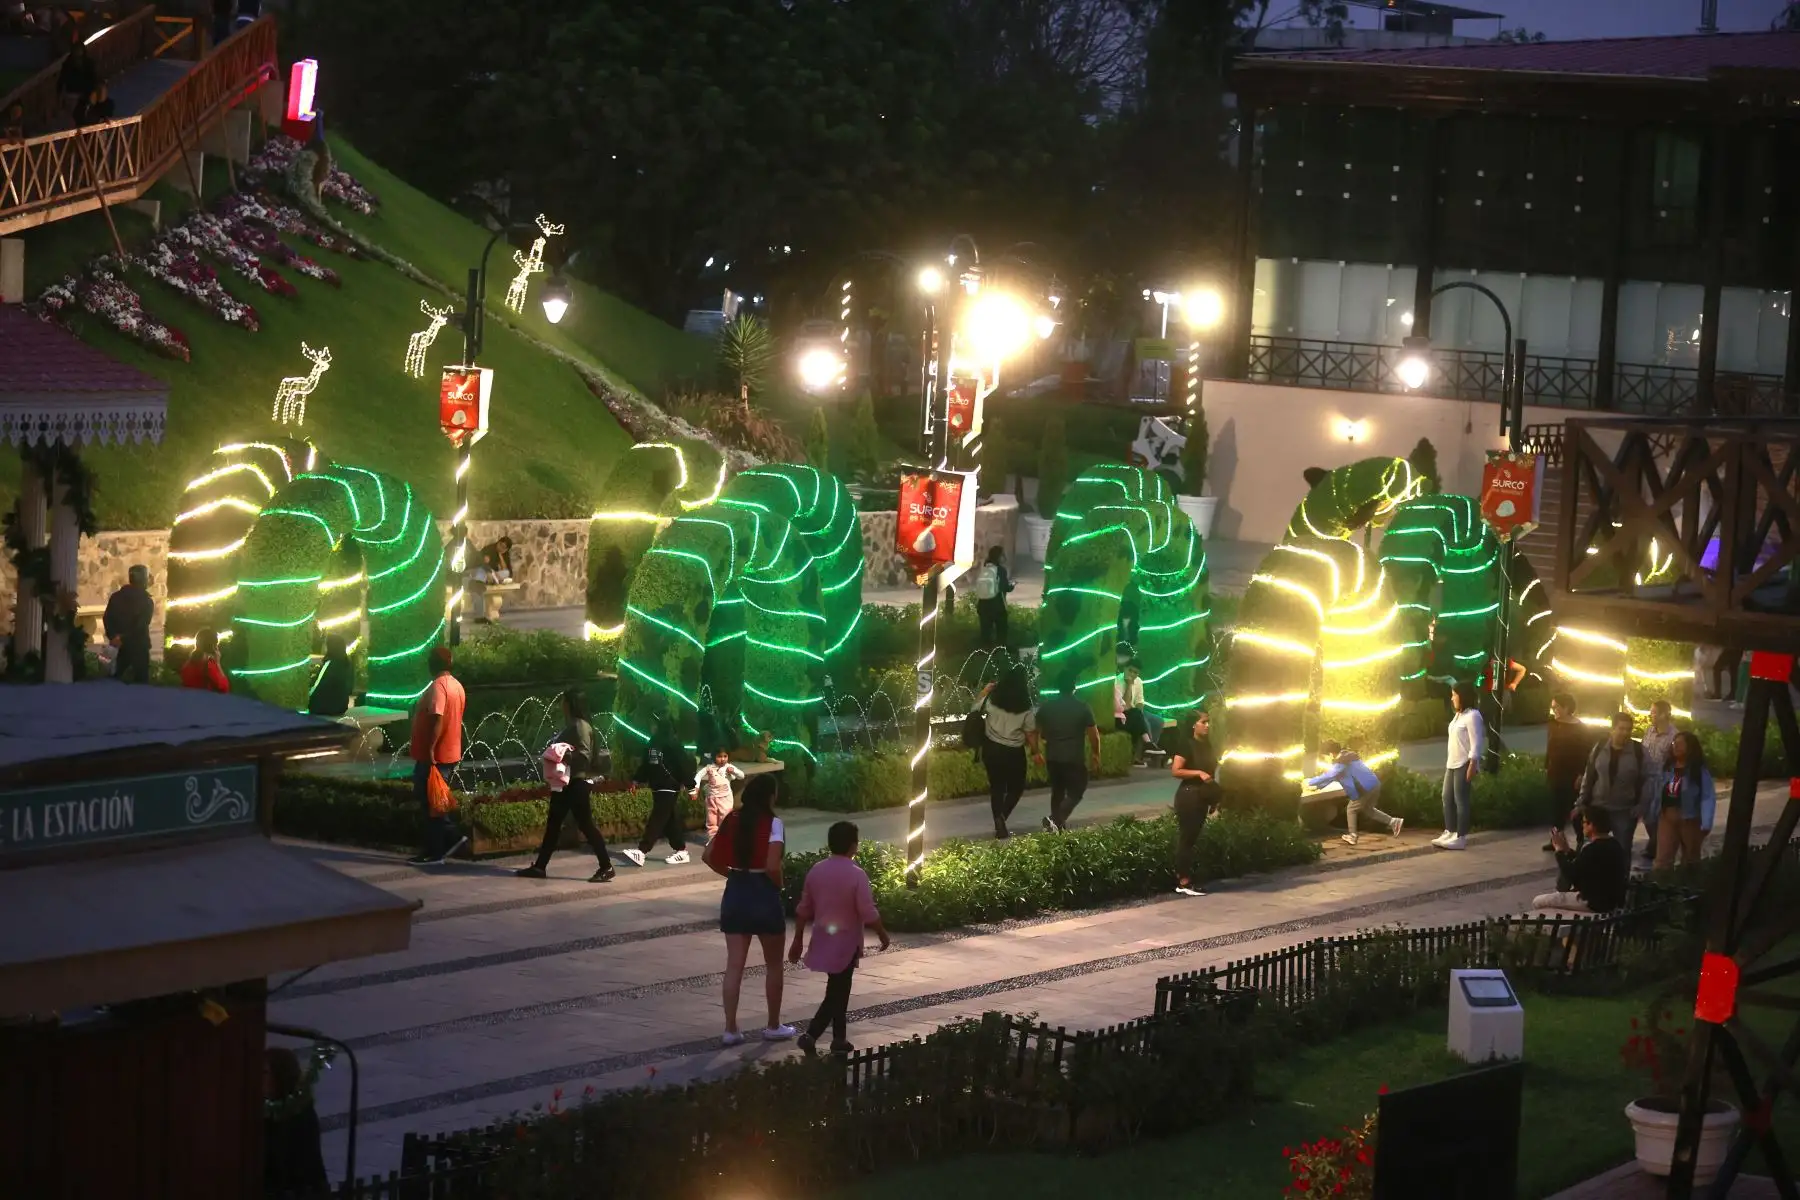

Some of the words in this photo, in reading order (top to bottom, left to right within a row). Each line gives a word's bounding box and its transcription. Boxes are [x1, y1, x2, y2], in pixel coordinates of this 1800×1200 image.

[447, 392, 474, 401] SURCO
[1492, 479, 1525, 490] SURCO
[909, 503, 948, 519] SURCO
[12, 806, 35, 842] LA
[43, 789, 136, 838] ESTACIÓN
